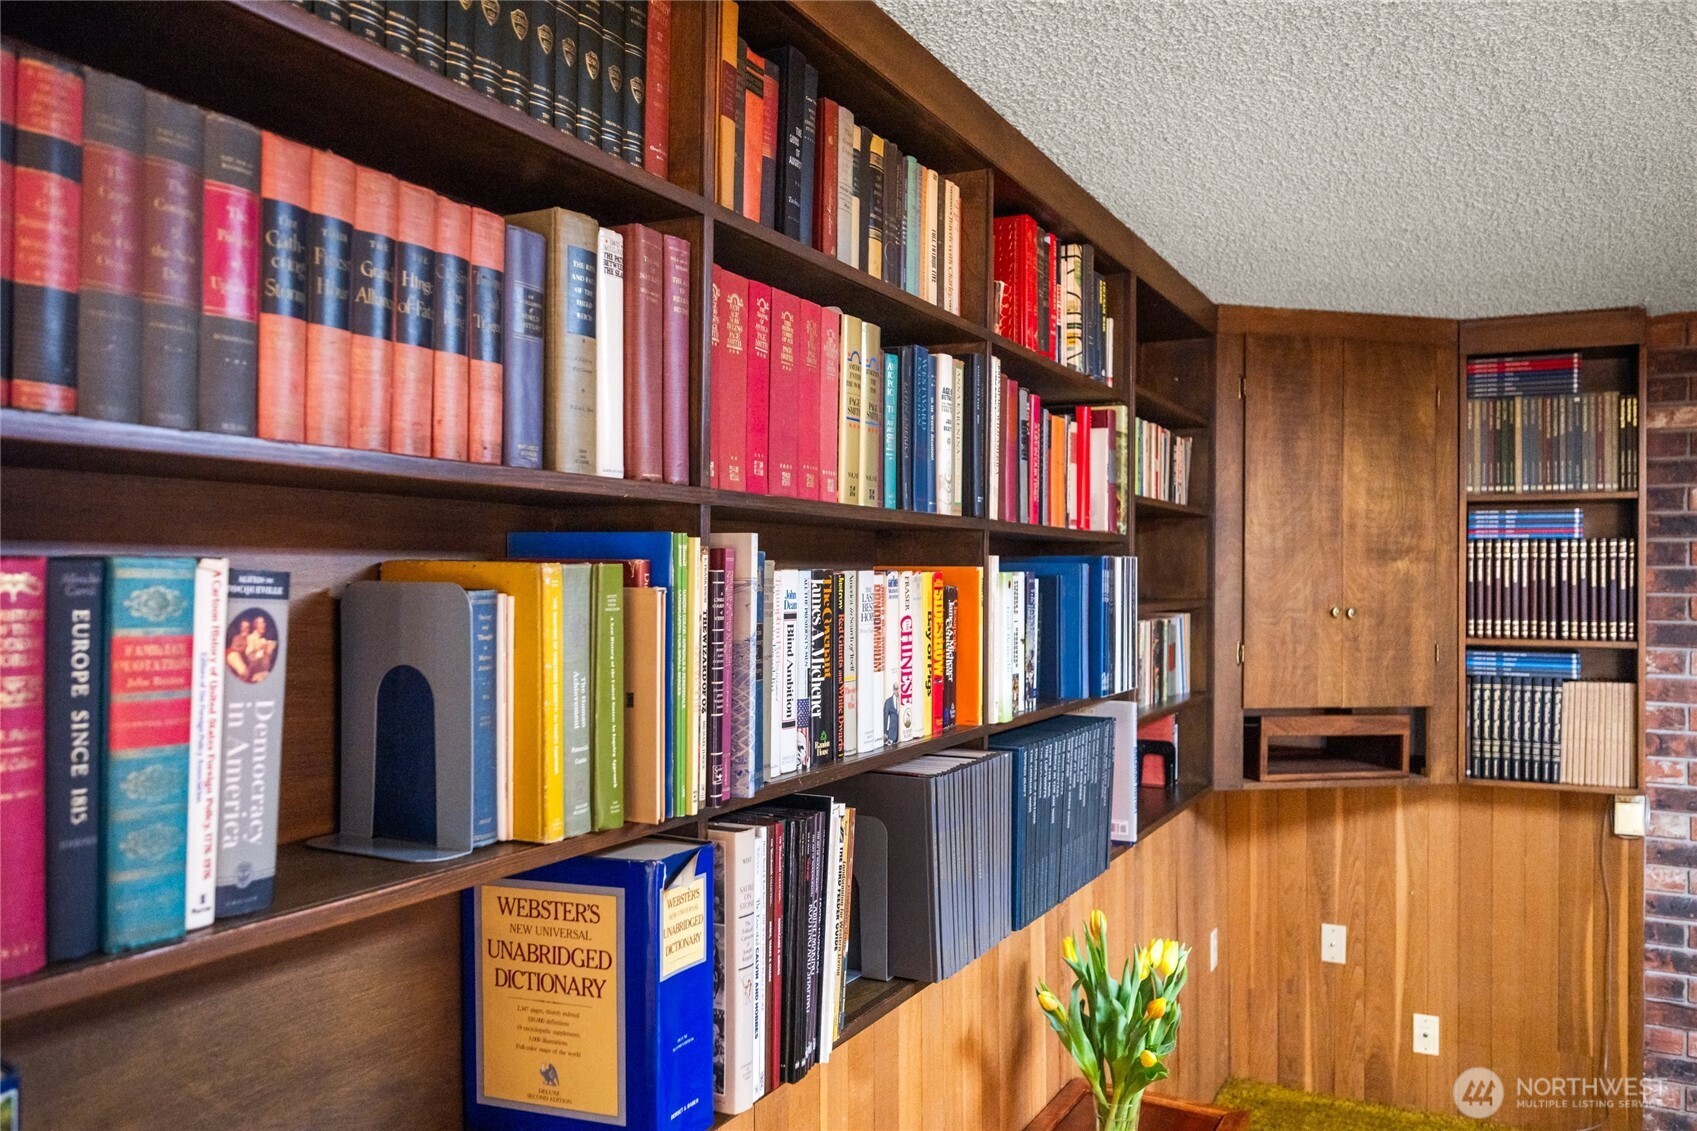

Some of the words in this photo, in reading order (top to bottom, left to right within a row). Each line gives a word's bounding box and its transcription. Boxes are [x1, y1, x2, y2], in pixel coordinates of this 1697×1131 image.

[212, 581, 223, 622] Cartoon
[784, 600, 797, 610] Dean
[785, 589, 797, 600] John
[812, 579, 824, 626] James
[824, 576, 833, 606] The
[209, 626, 220, 663] History
[786, 624, 794, 657] Blind
[812, 627, 824, 646] A.
[822, 607, 833, 678] Covenant
[70, 609, 91, 698] EUROPE
[900, 615, 913, 706] CHINESE
[208, 681, 220, 715] United
[786, 658, 794, 718] Ambition
[812, 646, 825, 718] Michener
[228, 701, 253, 728] in
[70, 710, 90, 778] SINCE
[206, 719, 218, 750] States
[204, 754, 216, 794] Foreign
[242, 700, 277, 846] Democracy
[222, 735, 252, 851] America
[497, 896, 601, 924] WEBSTER'S
[667, 888, 701, 910] WEBSTER'S
[510, 924, 533, 934] NEW
[535, 926, 592, 941] UNIVERSAL
[664, 914, 704, 939] UNABRIDGED
[487, 939, 613, 971] UNABRIDGED
[666, 932, 702, 957] DICTIONARY
[495, 968, 607, 999] DICTIONARY
